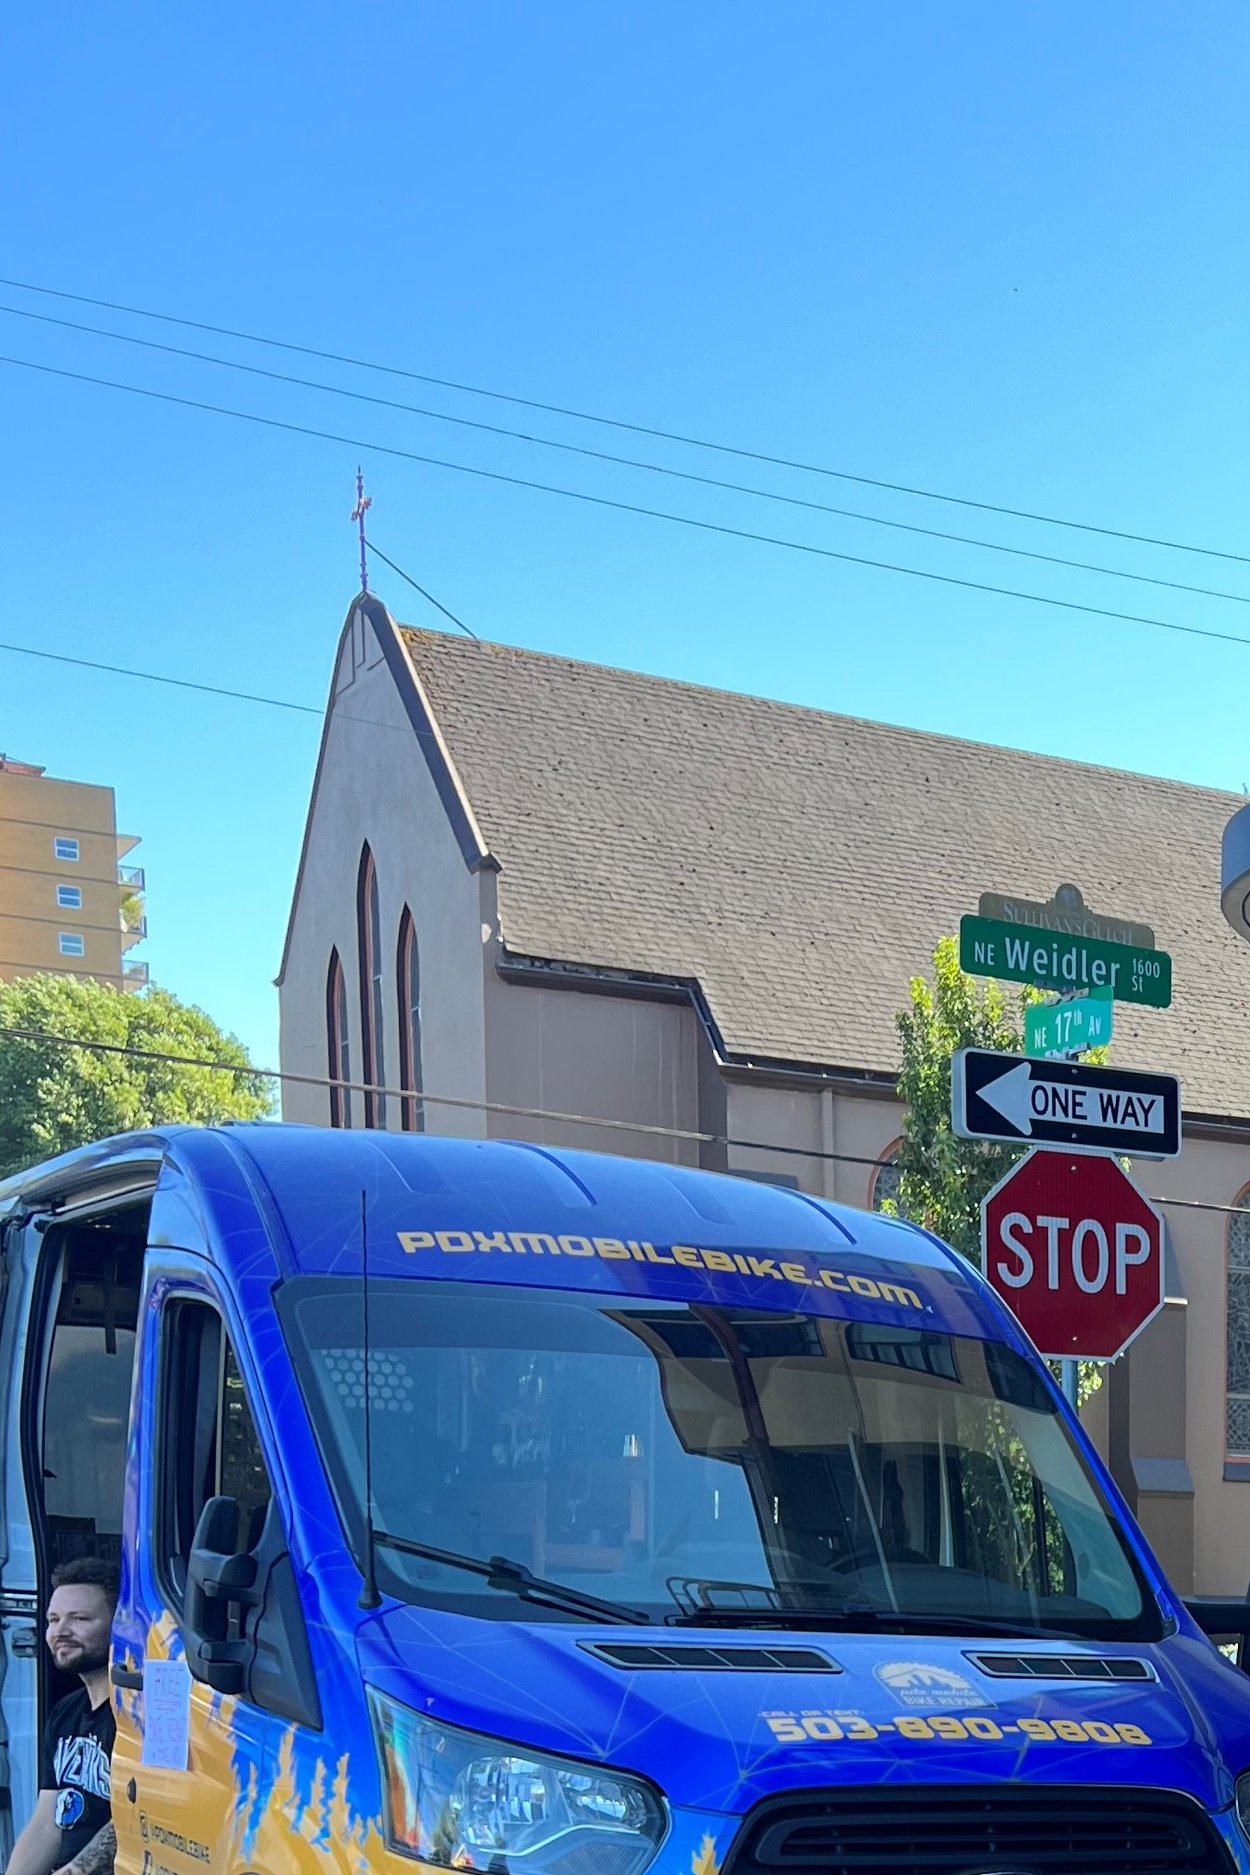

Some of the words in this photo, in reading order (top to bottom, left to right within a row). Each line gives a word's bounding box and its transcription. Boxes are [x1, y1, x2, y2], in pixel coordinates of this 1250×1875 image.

[975, 941, 995, 966] NE
[1005, 937, 1121, 987] Weidler
[1132, 976, 1143, 992] St
[1132, 958, 1160, 979] 1600
[1034, 1027, 1047, 1049] NE
[1055, 1011, 1082, 1044] 17th
[1088, 1016, 1101, 1037] Av
[1031, 1085, 1087, 1121] ONE
[1099, 1093, 1156, 1128] WAY
[396, 1230, 923, 1310] PDXMOBILEBIKE.COM
[997, 1212, 1151, 1295] STOP
[766, 1716, 1153, 1746] 503-890-9808
